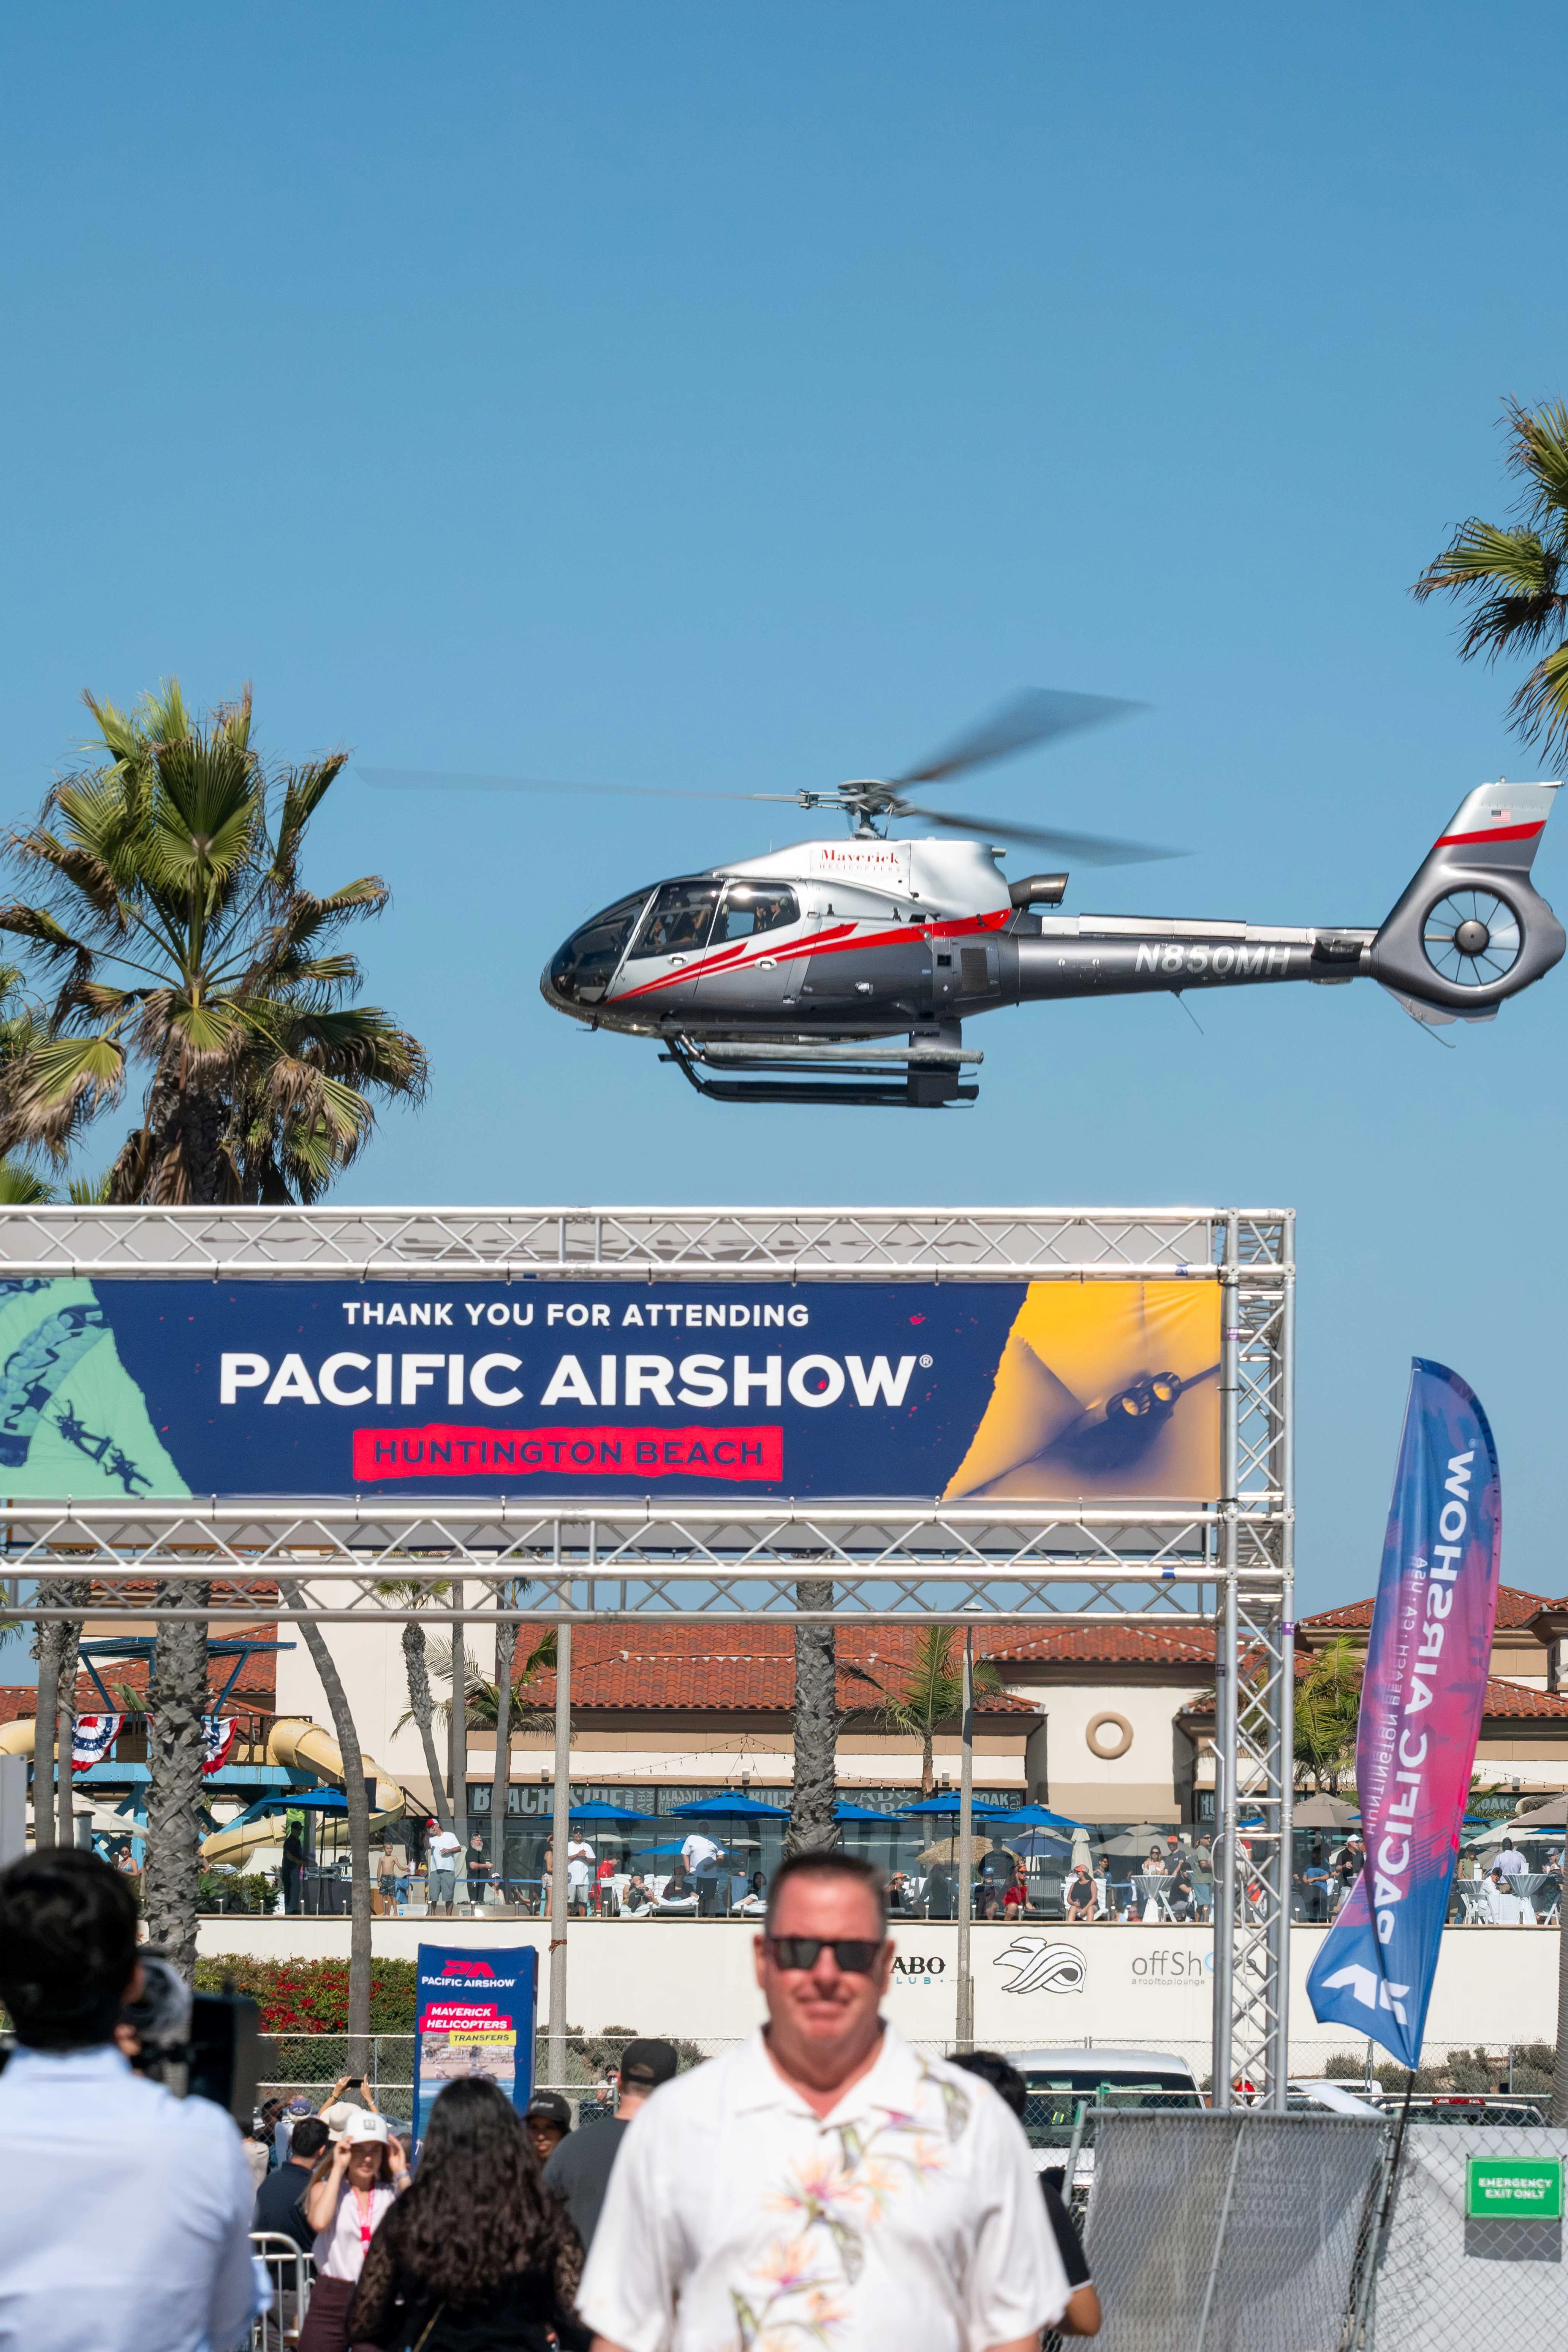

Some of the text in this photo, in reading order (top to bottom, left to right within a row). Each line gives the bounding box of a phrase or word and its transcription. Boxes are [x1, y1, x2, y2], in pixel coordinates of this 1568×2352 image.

[822, 850, 899, 864] Maverick
[1135, 943, 1291, 975] N850MH
[343, 1303, 809, 1326] THANK YOU FOR ATTENDING
[220, 1352, 524, 1406] PACIFIC
[375, 1440, 763, 1465] HUNTINGTON BEACH
[474, 1788, 555, 1813] BACH
[890, 1956, 946, 1975] ABO
[422, 1976, 515, 1988] PACIFIC AIRSHOW
[431, 2007, 492, 2016] MAVERICK
[426, 2019, 508, 2029] HELICOPTERS
[1479, 2178, 1553, 2188] EMERGENCY
[1486, 2189, 1546, 2199] EXIT ONLY
